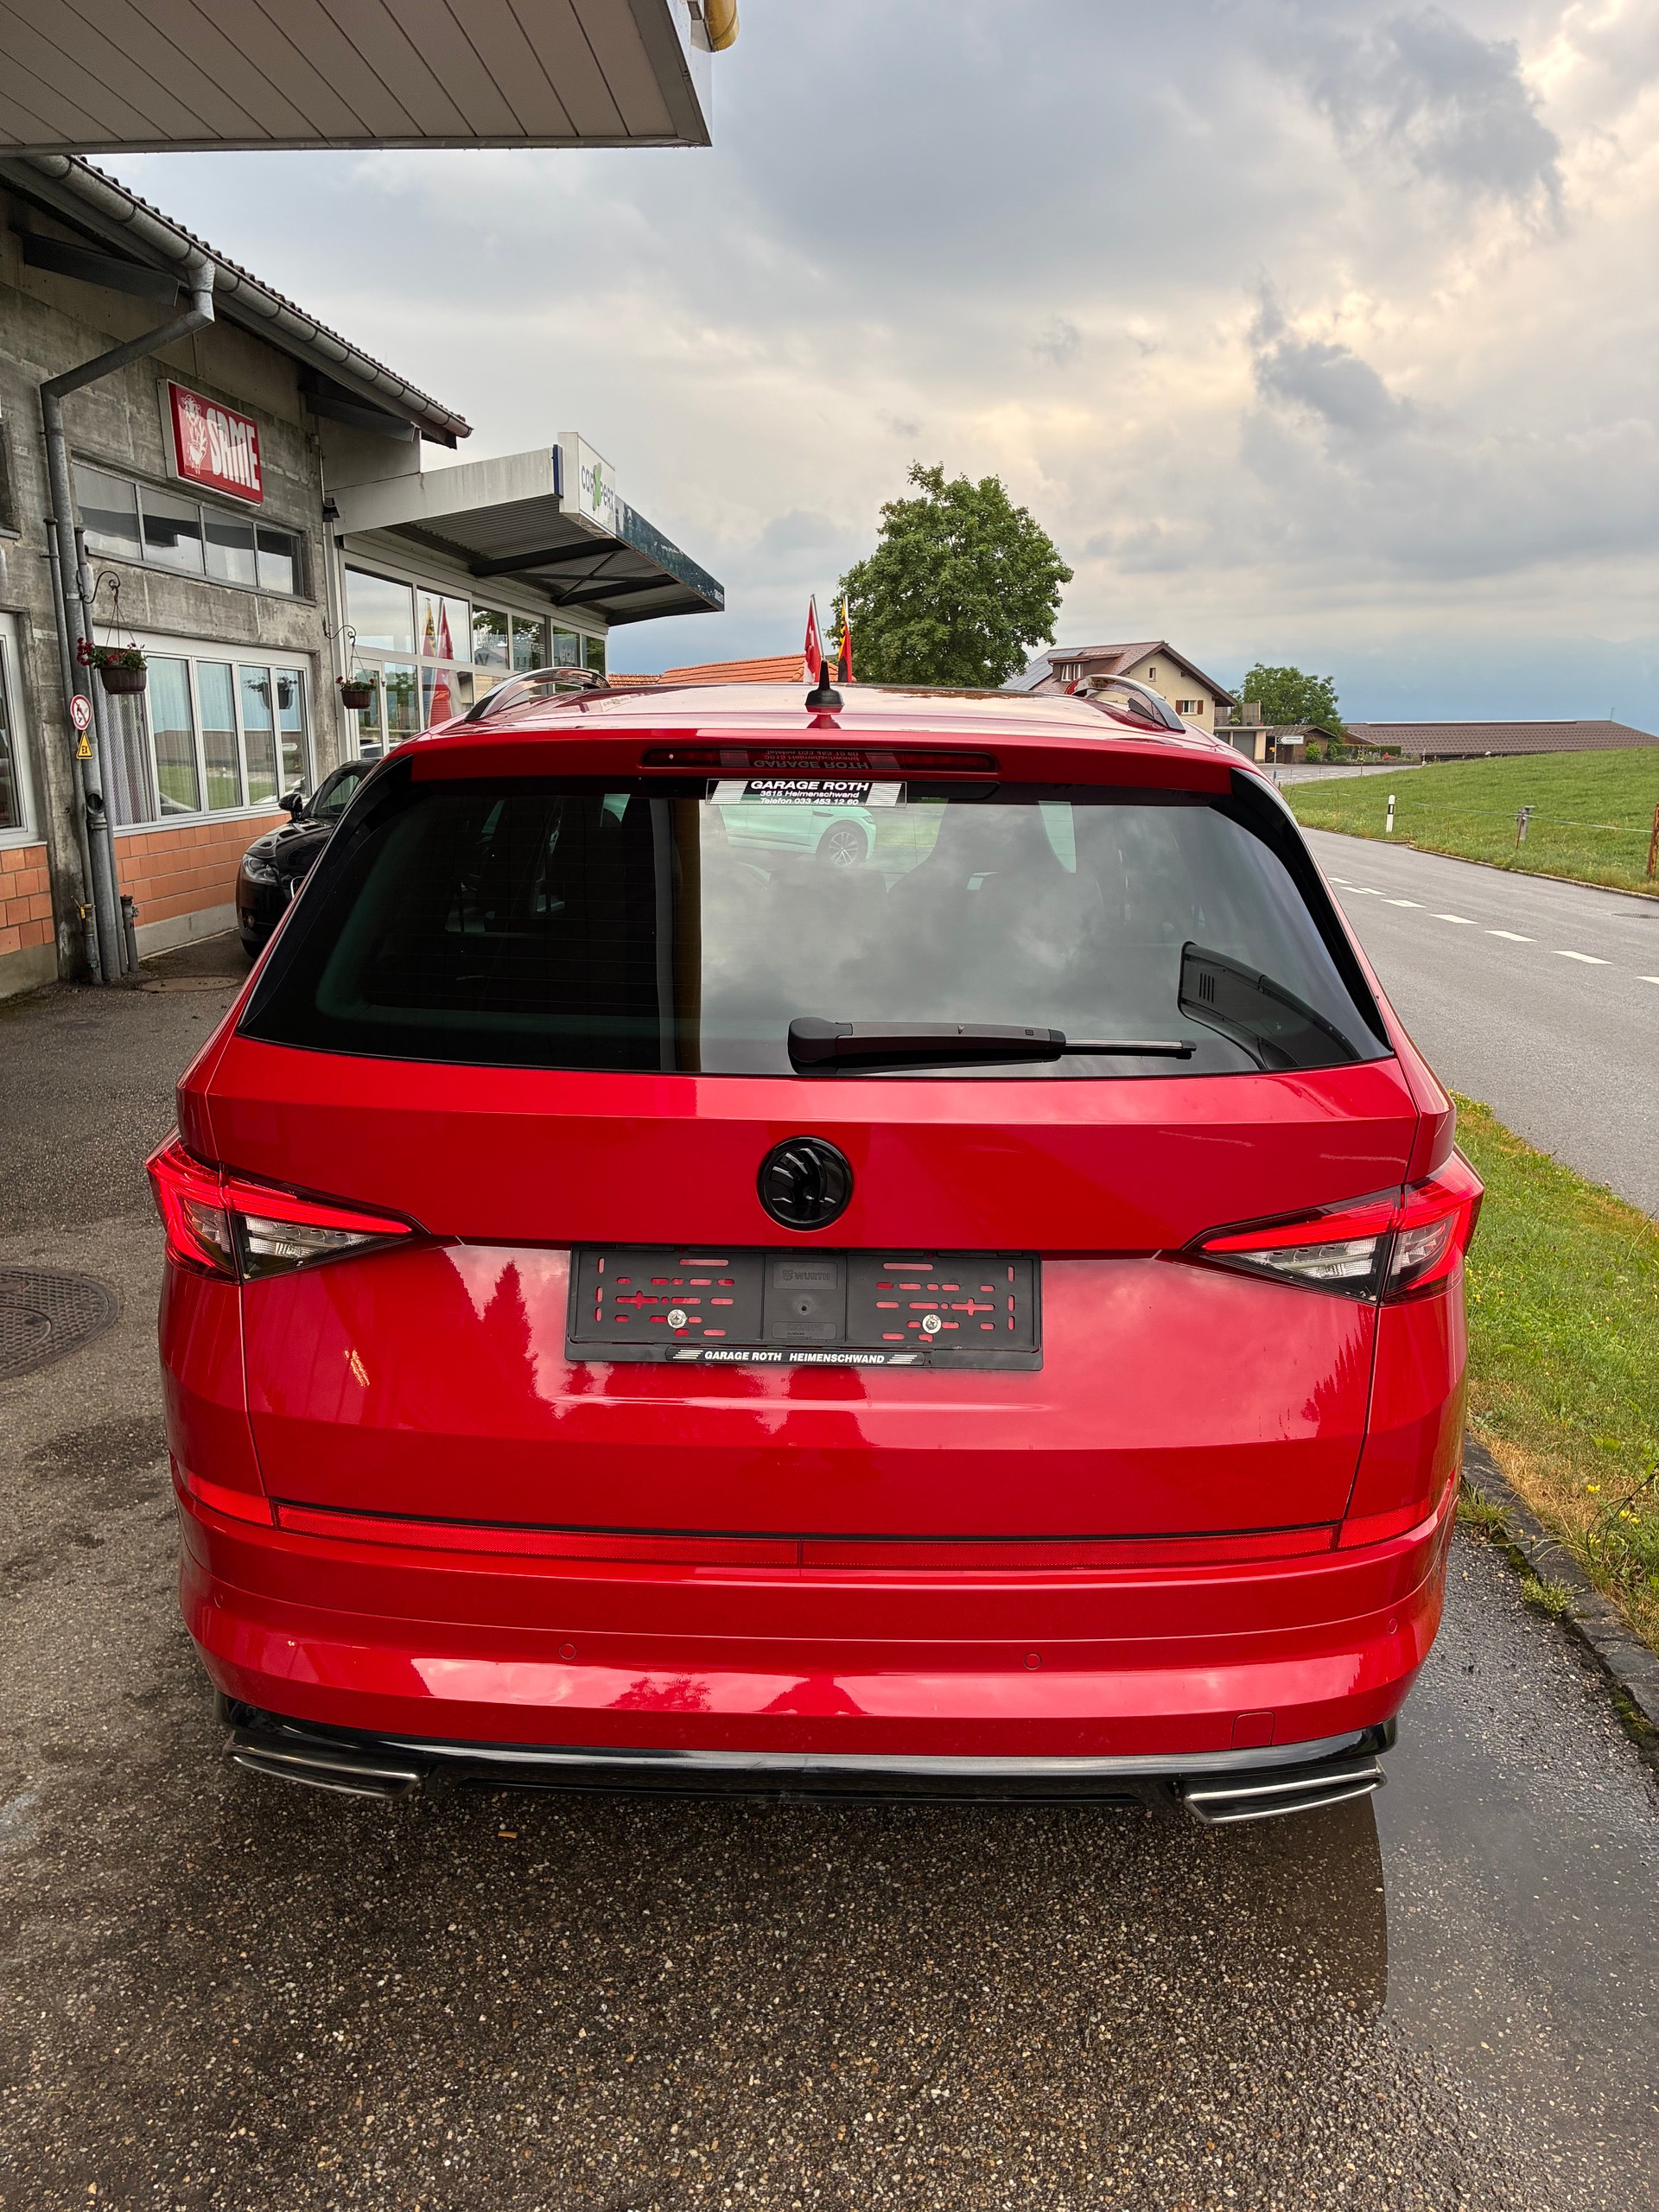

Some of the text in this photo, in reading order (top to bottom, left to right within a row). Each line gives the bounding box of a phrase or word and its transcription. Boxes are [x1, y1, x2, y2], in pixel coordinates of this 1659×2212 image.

[206, 407, 261, 492] SAME
[750, 780, 870, 791] GARAGE ROTH
[785, 790, 861, 798] Heimenschwand
[704, 1351, 885, 1364] GARAGE ROTH HEIMENSCHWAND
